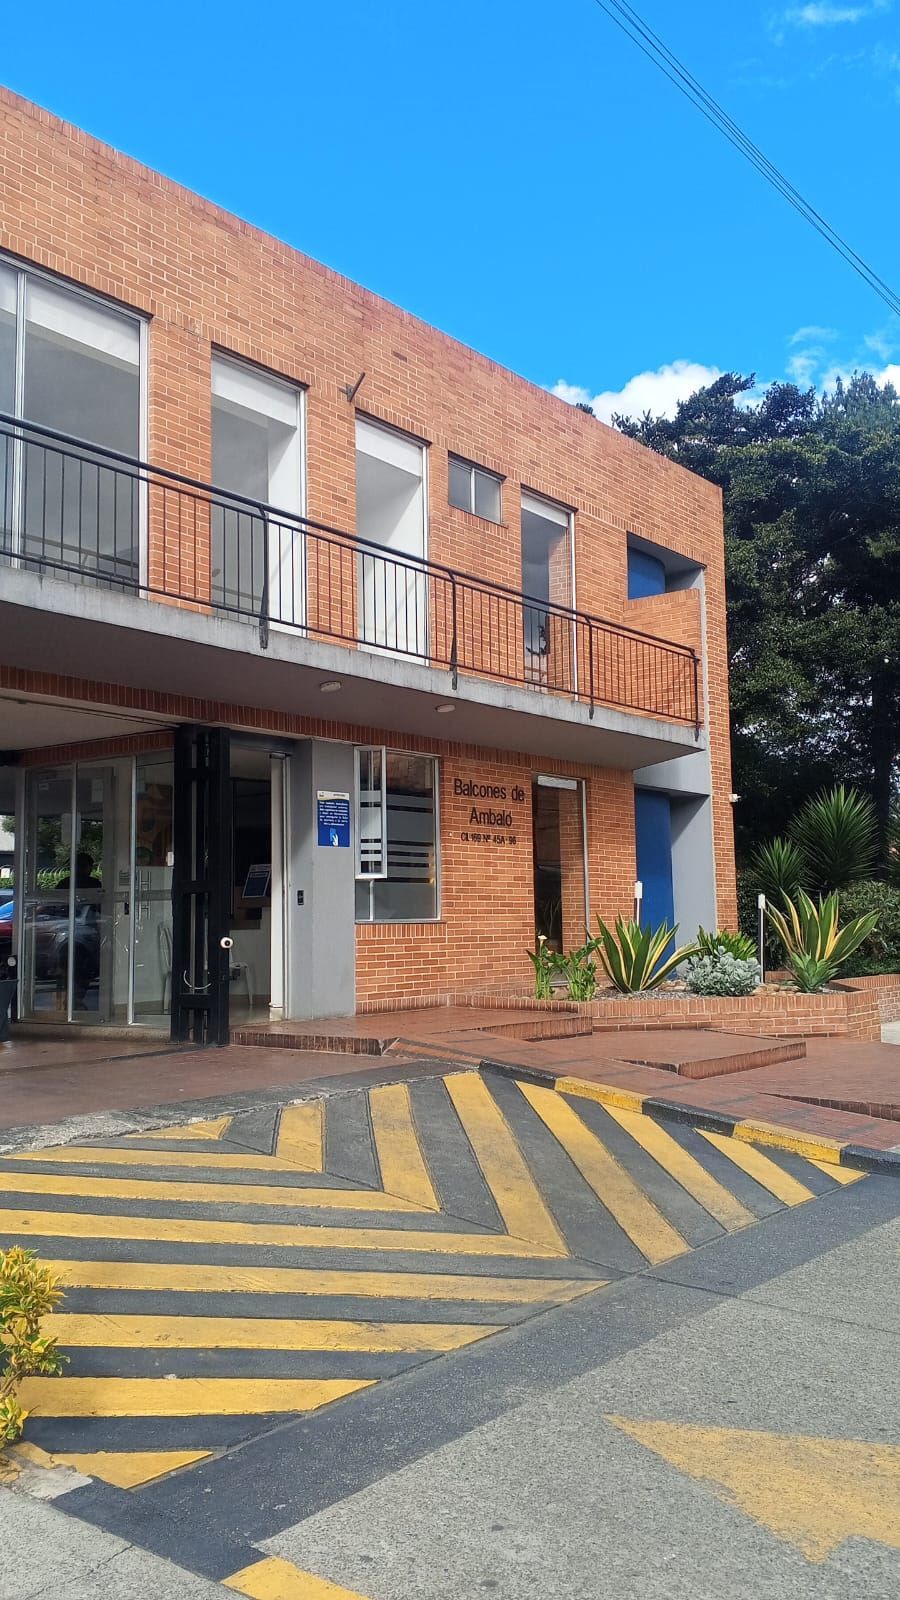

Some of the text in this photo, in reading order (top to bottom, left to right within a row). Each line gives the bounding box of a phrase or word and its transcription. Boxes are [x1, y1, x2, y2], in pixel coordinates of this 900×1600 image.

[454, 778, 524, 801] Balcones de
[469, 807, 512, 826] Ambaló
[493, 834, 505, 844] 45A
